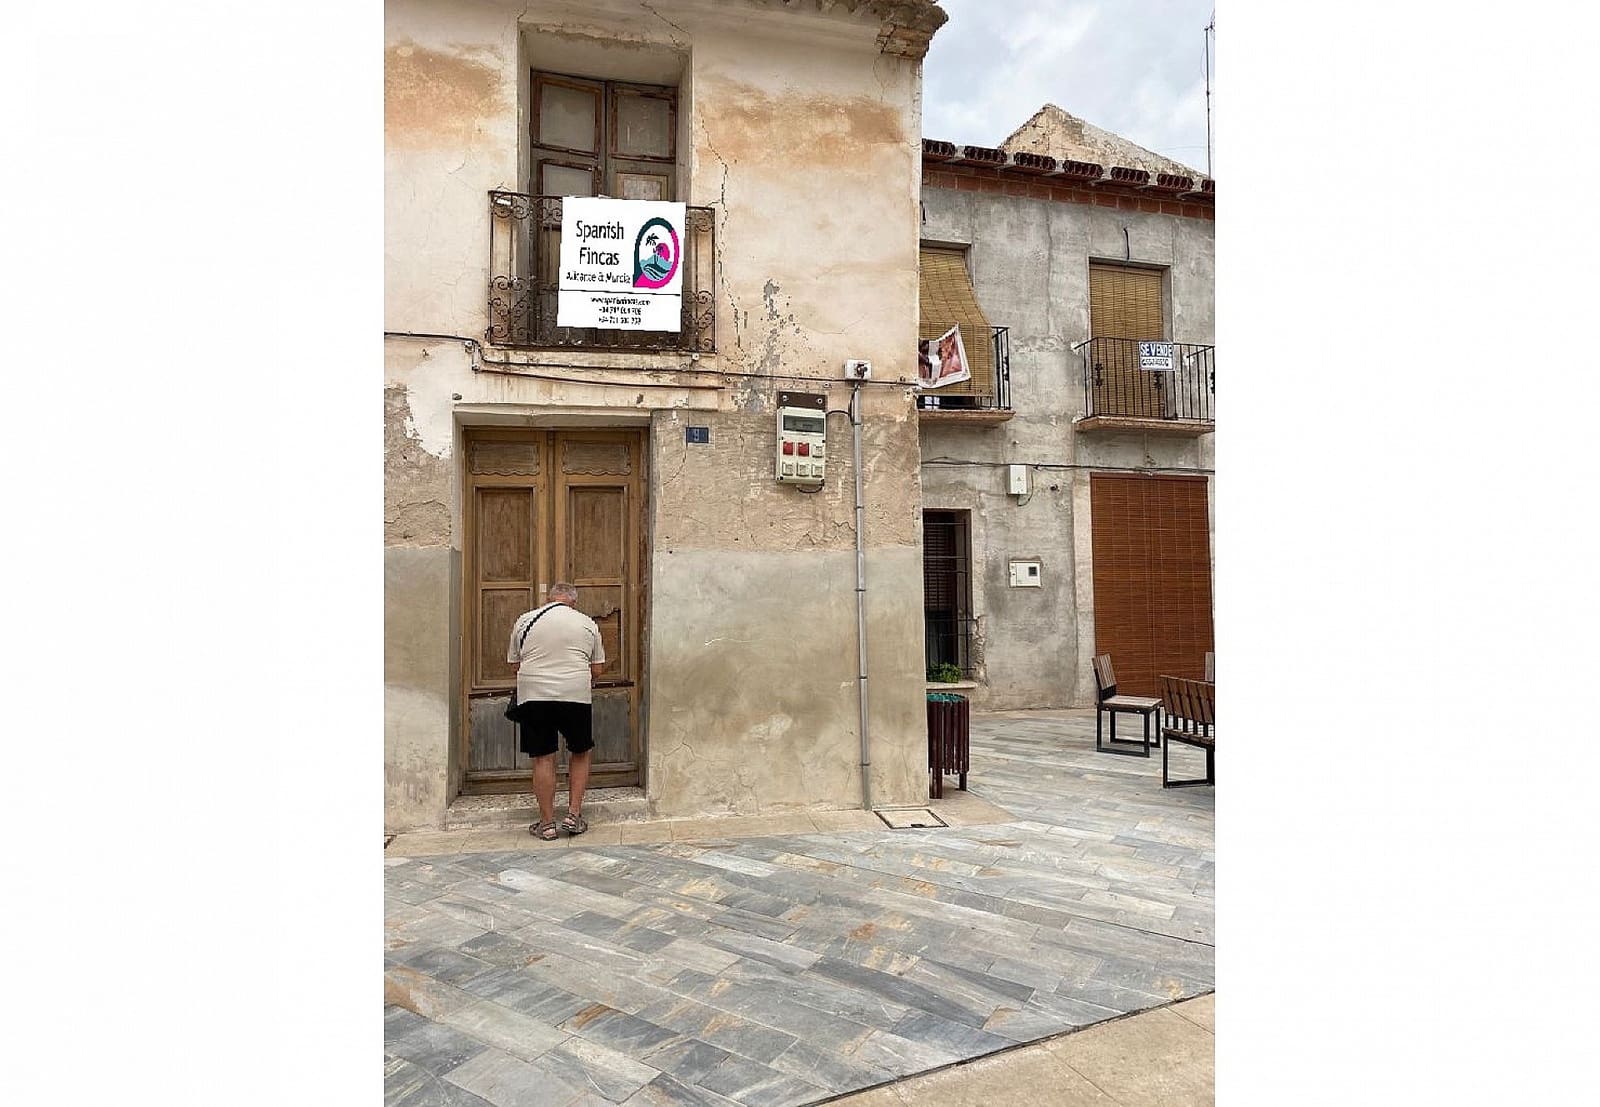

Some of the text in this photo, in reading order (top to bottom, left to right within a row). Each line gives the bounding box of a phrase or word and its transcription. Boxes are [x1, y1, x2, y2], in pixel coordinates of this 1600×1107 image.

[576, 220, 624, 242] Spanish
[579, 247, 620, 266] Fincas
[605, 272, 631, 284] Murcia
[1140, 343, 1174, 357] SE VENDE
